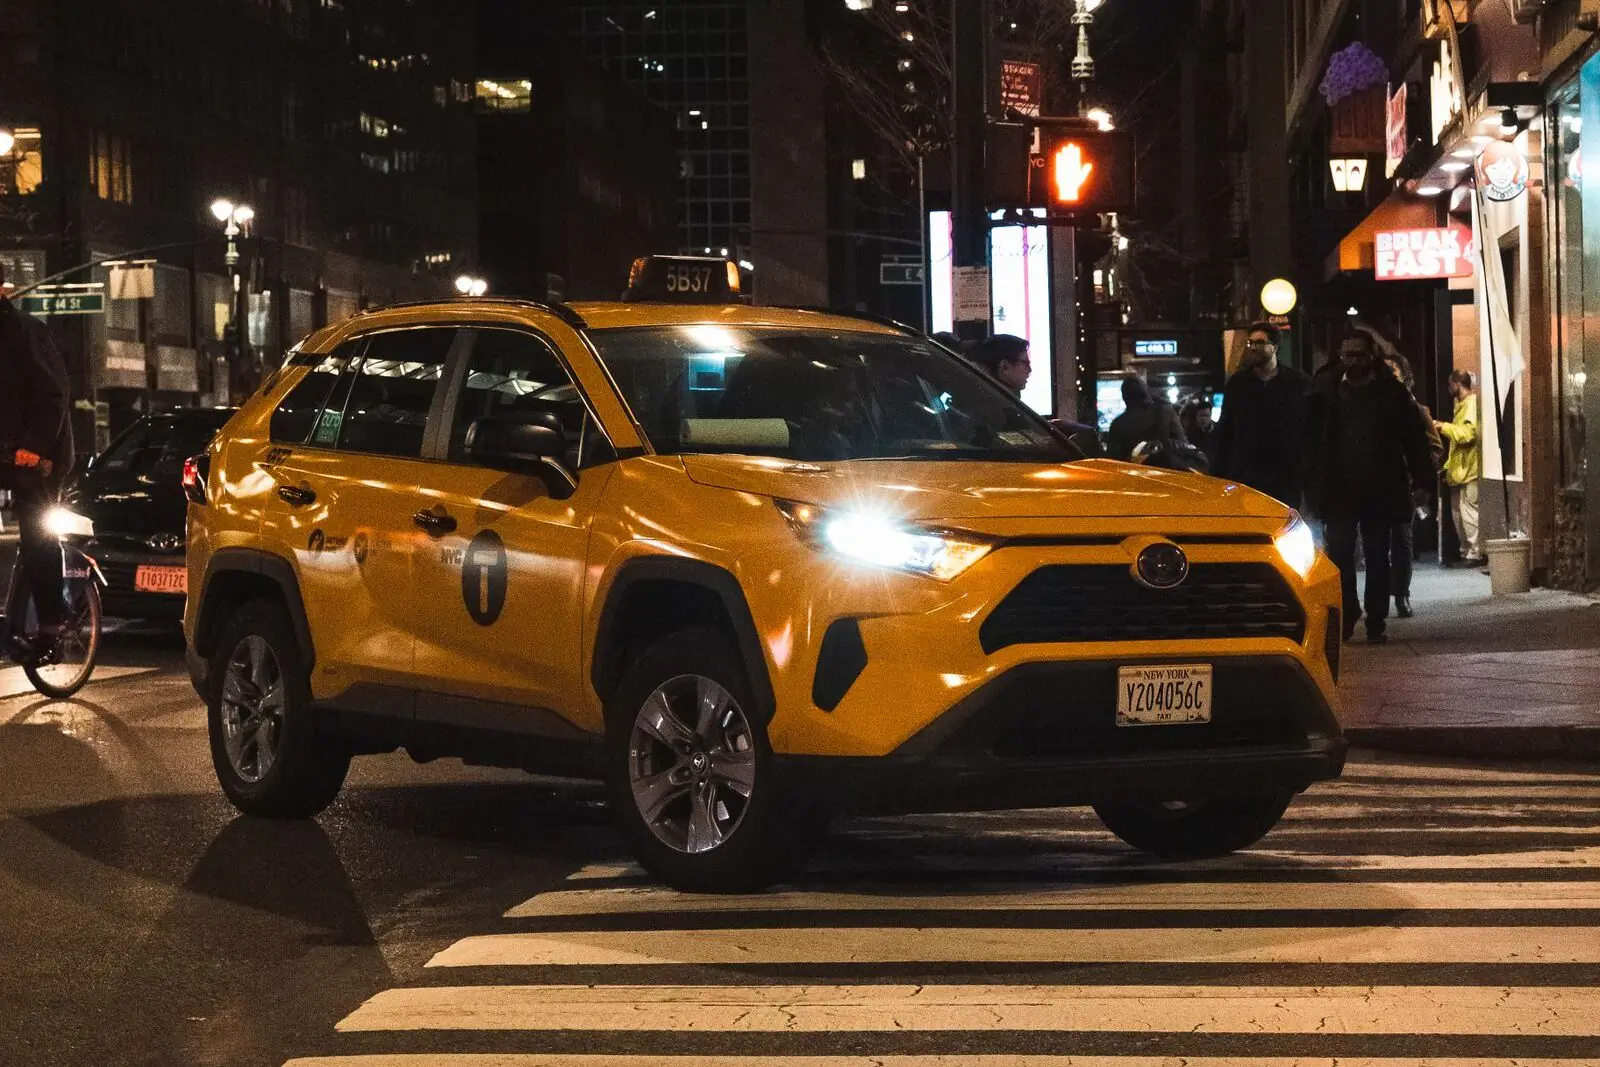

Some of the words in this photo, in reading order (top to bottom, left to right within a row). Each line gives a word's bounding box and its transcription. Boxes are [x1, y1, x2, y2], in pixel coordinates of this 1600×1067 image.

[1376, 230, 1460, 250] BREAK
[1377, 248, 1460, 276] FAST
[667, 265, 711, 293] 5B37
[1143, 671, 1165, 680] NEW
[1167, 669, 1190, 680] YORK
[1127, 681, 1204, 712] Y204056C
